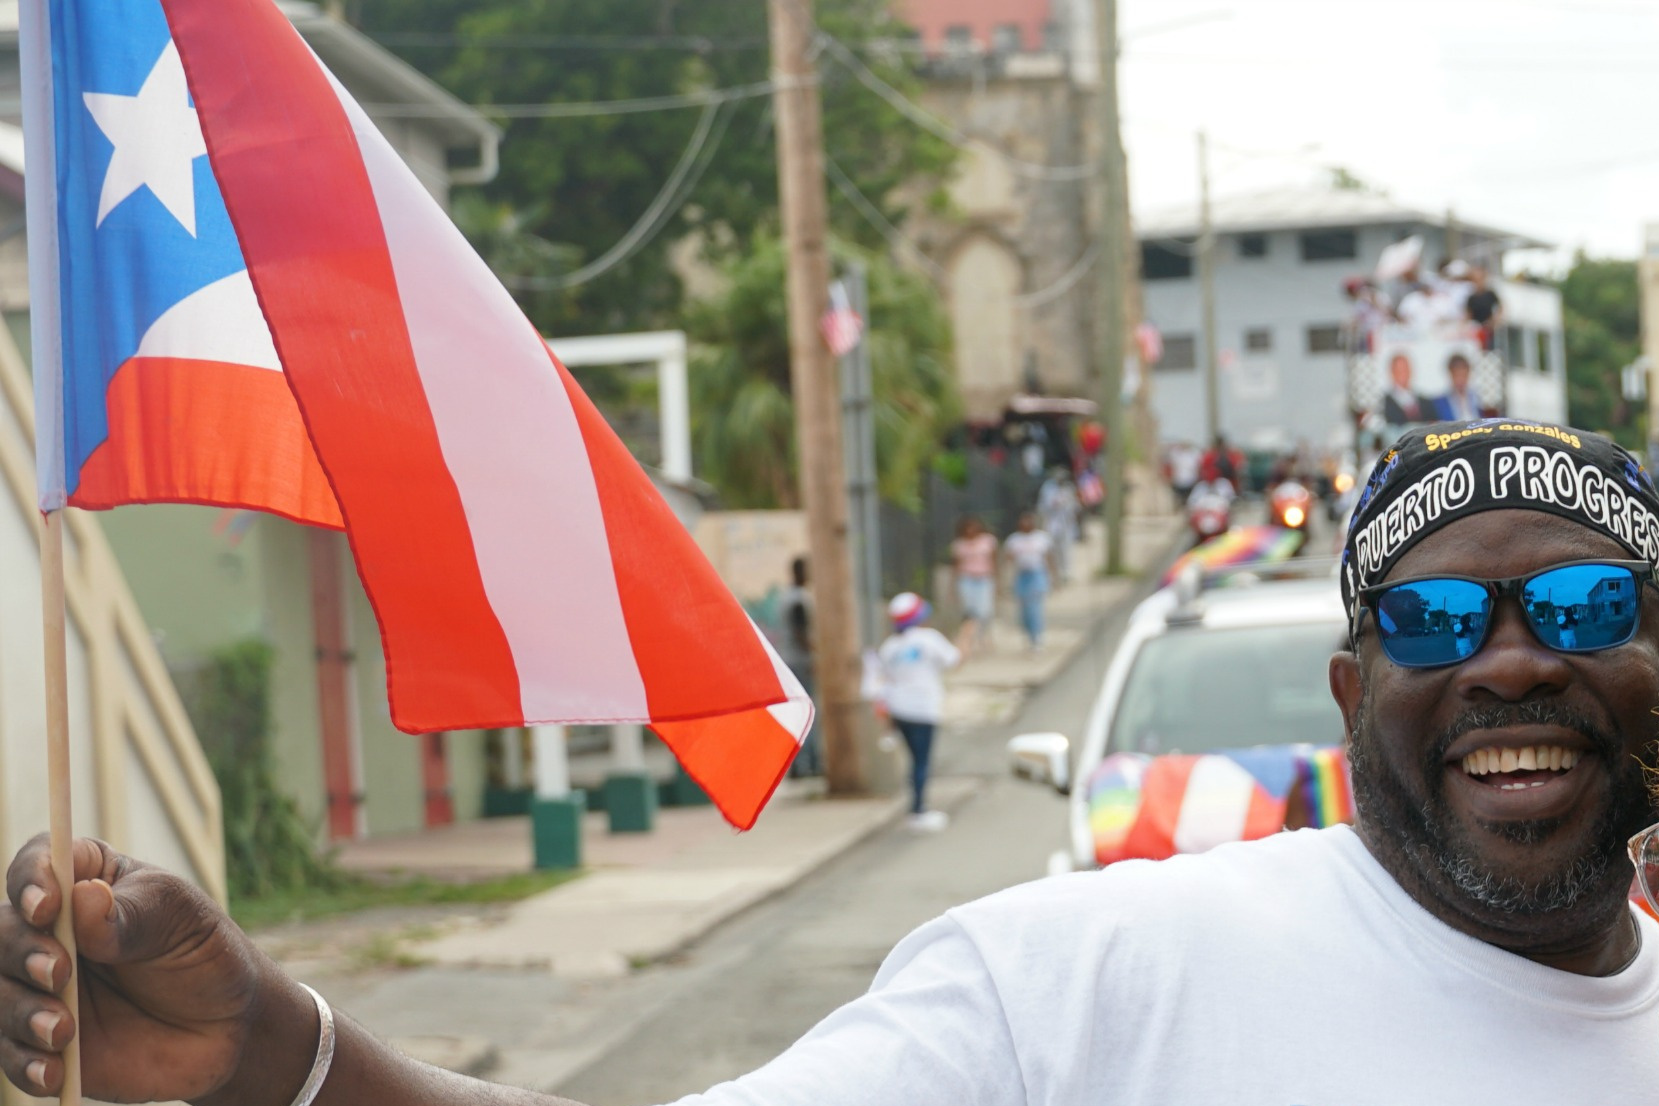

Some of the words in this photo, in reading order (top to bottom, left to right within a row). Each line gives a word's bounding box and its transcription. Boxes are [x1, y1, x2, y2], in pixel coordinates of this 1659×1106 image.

[1425, 427, 1493, 452] Speedy
[1499, 424, 1581, 449] Gonzales
[1355, 458, 1474, 590] PUERTO
